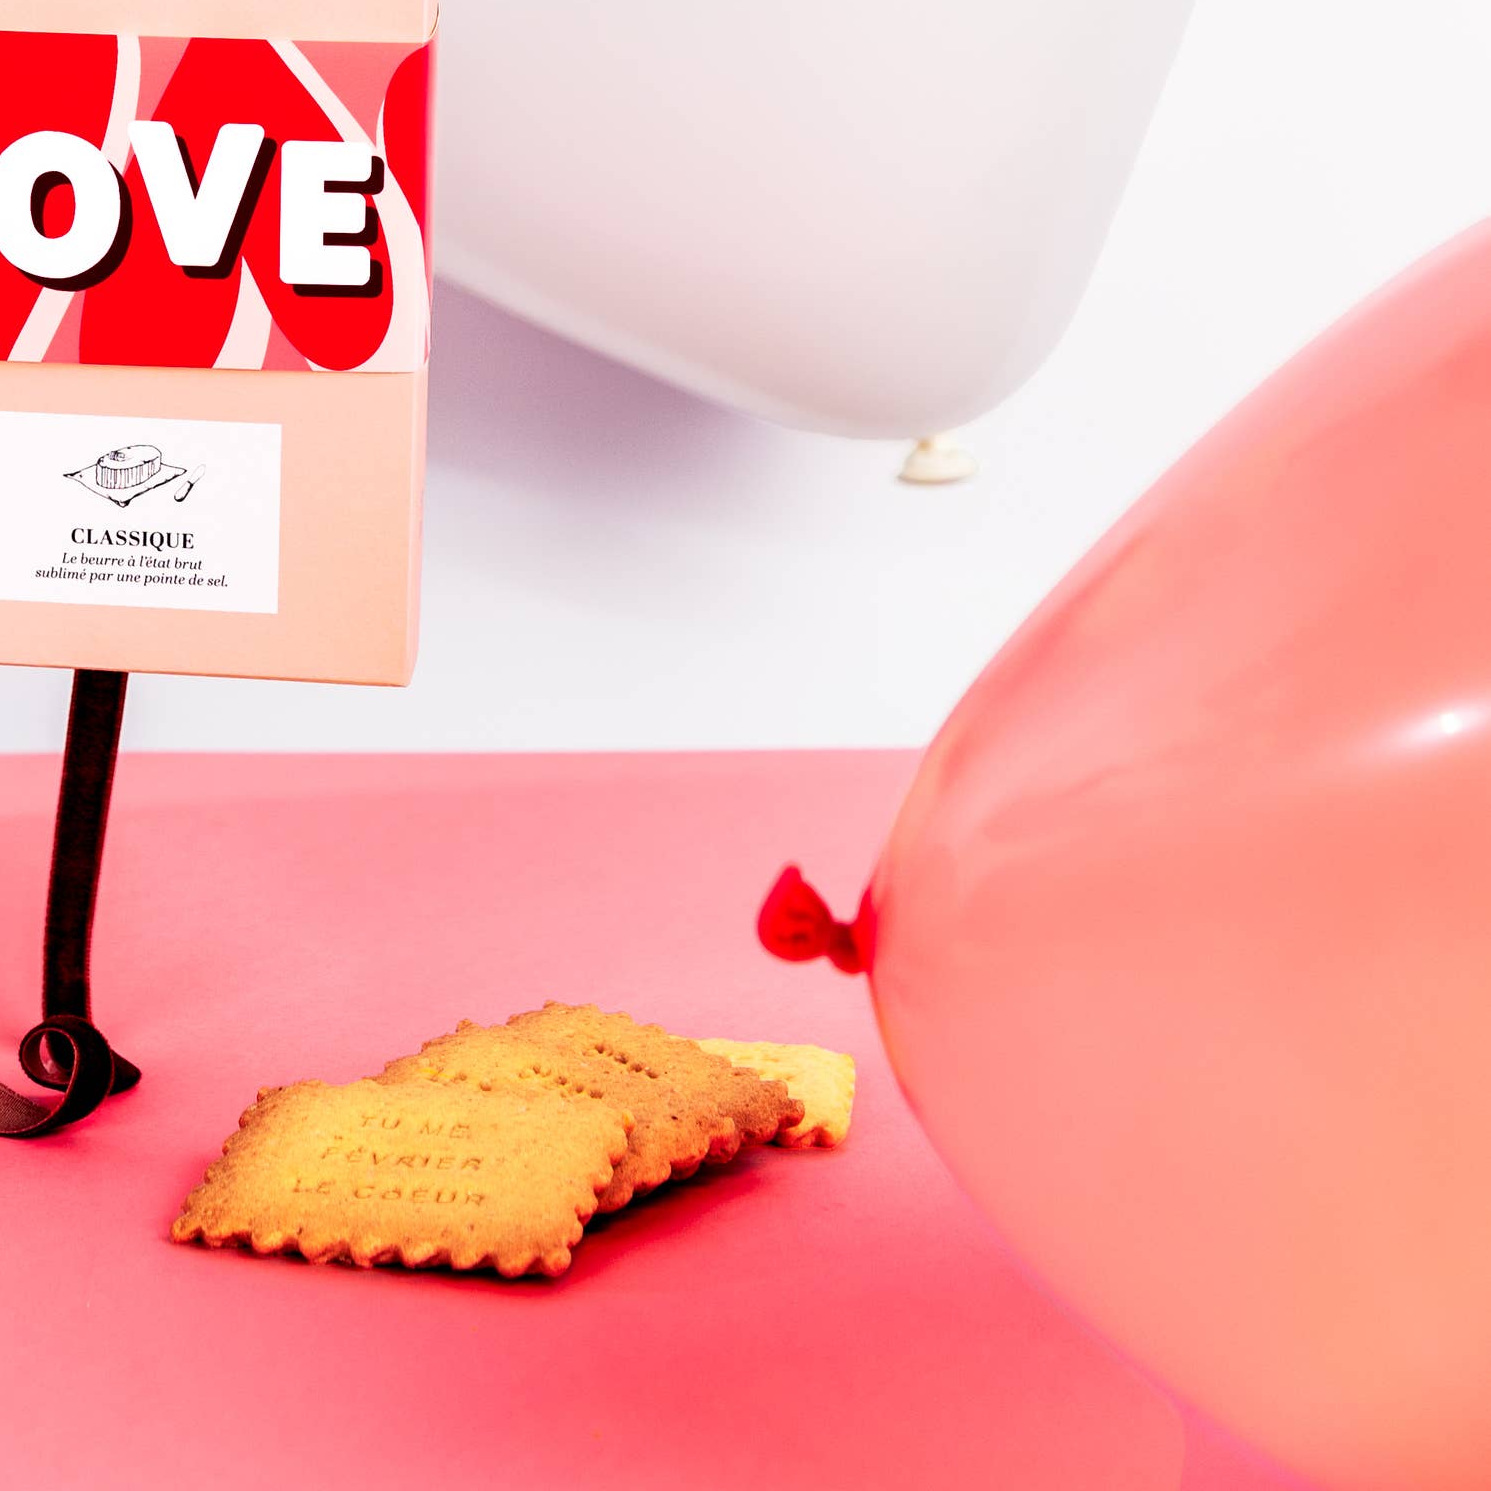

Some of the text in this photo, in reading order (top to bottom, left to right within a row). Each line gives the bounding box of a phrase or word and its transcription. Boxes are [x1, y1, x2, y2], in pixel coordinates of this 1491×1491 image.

[70, 527, 195, 552] CLASSIQUE
[62, 552, 78, 564] Le
[80, 552, 125, 567] beurre
[127, 555, 136, 567] à
[174, 557, 202, 570] brut
[35, 566, 229, 587] sublimé par une pointe de sel.
[360, 1114, 472, 1140] TU ME
[292, 1179, 336, 1195] LE
